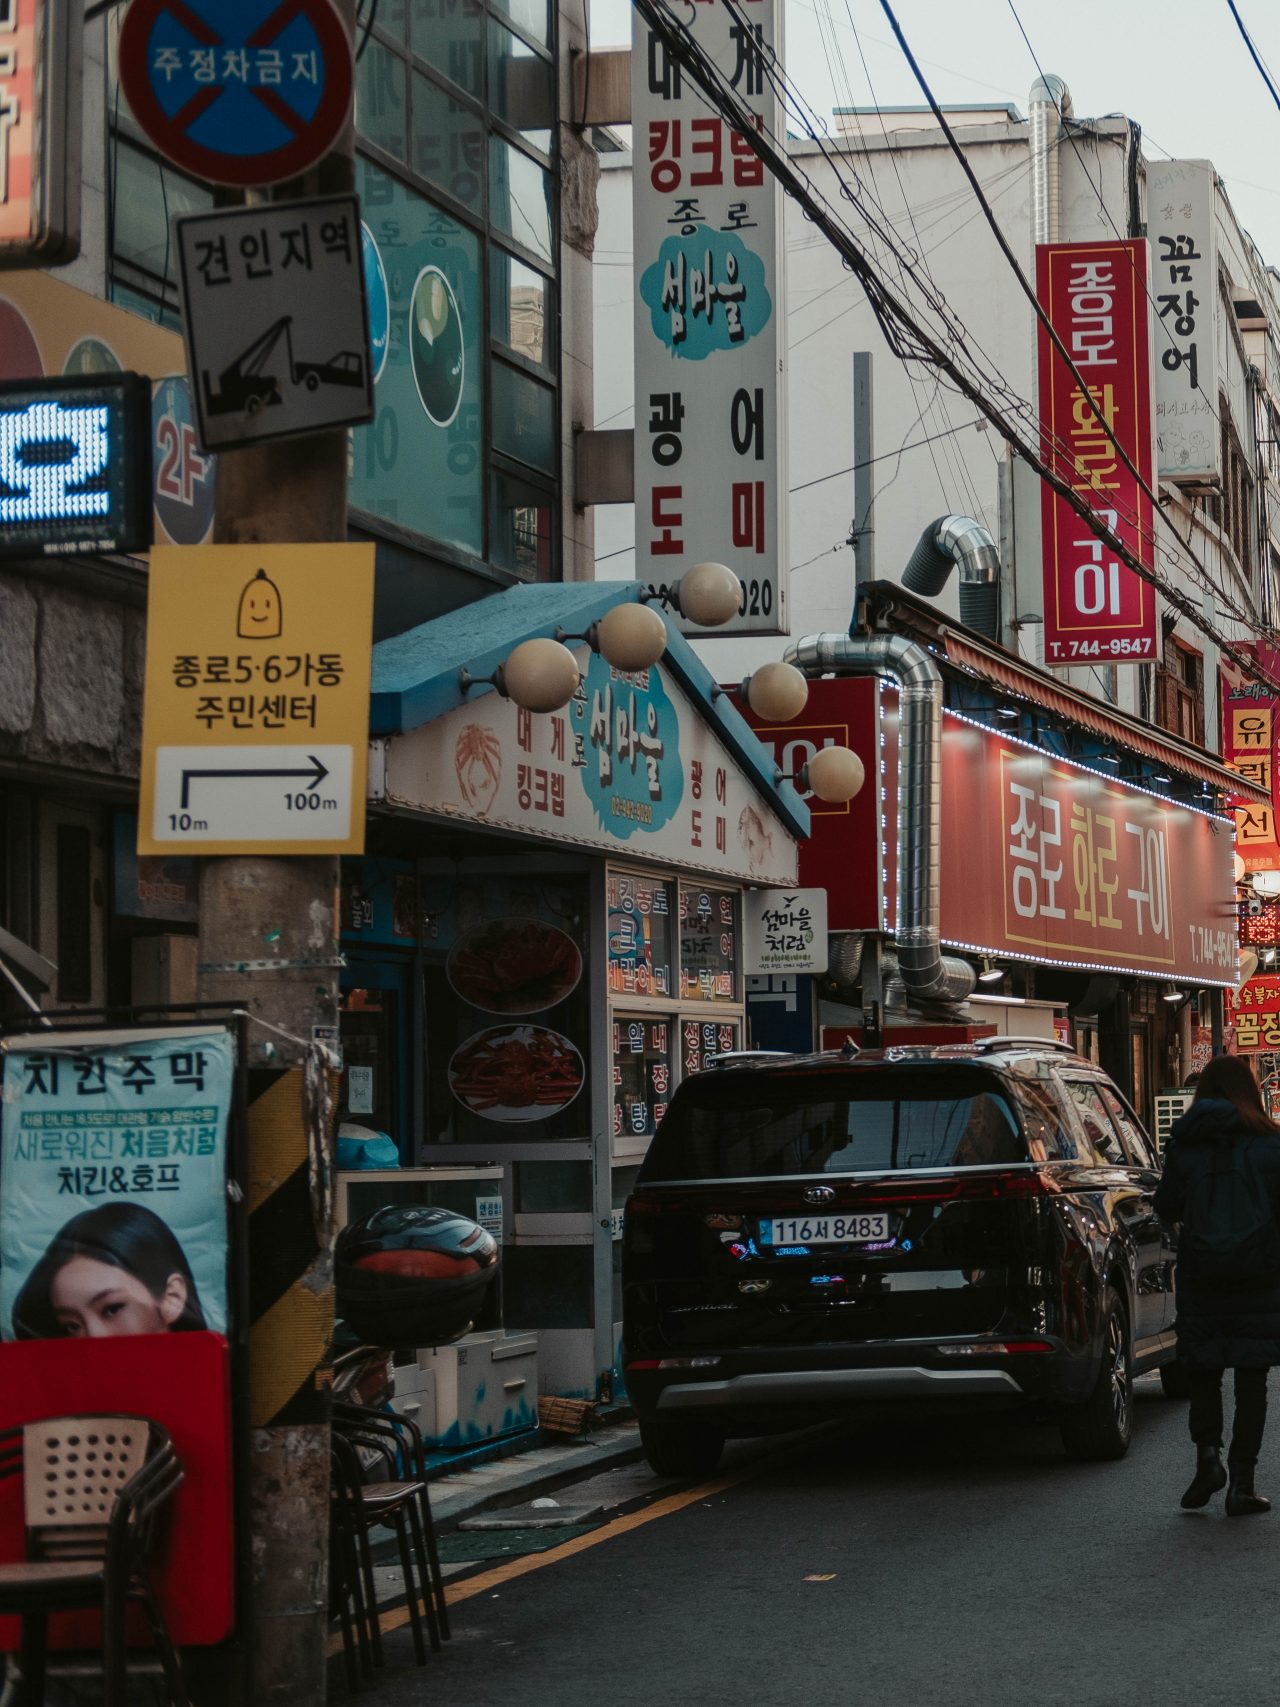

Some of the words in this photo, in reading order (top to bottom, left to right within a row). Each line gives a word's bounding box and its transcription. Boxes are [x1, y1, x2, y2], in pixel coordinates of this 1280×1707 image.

[153, 45, 321, 85] 주정차금지
[648, 115, 764, 193] 킹크랩
[667, 199, 758, 236] 종로
[194, 216, 354, 285] 견인지역
[660, 248, 748, 345] 섬마을
[1157, 235, 1201, 389] 꼼장어
[648, 388, 765, 466] 광어
[156, 413, 207, 507] 2F
[650, 481, 766, 555] 도미
[1069, 637, 1153, 657] 744-9547
[171, 653, 344, 687] 종로5·6가동
[195, 695, 317, 728] 주민센터
[517, 713, 566, 762] 대게
[590, 684, 664, 801] 섬마을
[284, 793, 338, 811] 100m
[517, 763, 566, 818] 킹크랩
[691, 759, 727, 806] 광어
[168, 813, 208, 832] 10m
[691, 810, 727, 855] 도미
[761, 907, 812, 931] 섬마을
[764, 934, 806, 952] 처럼
[23, 1052, 208, 1095] 치킨주막
[628, 1022, 647, 1133] 알탕
[14, 1131, 114, 1161] 새로워진
[120, 1126, 217, 1158] 처음처럼
[57, 1164, 180, 1195] 치킨&호프
[832, 1216, 885, 1239] 8483
